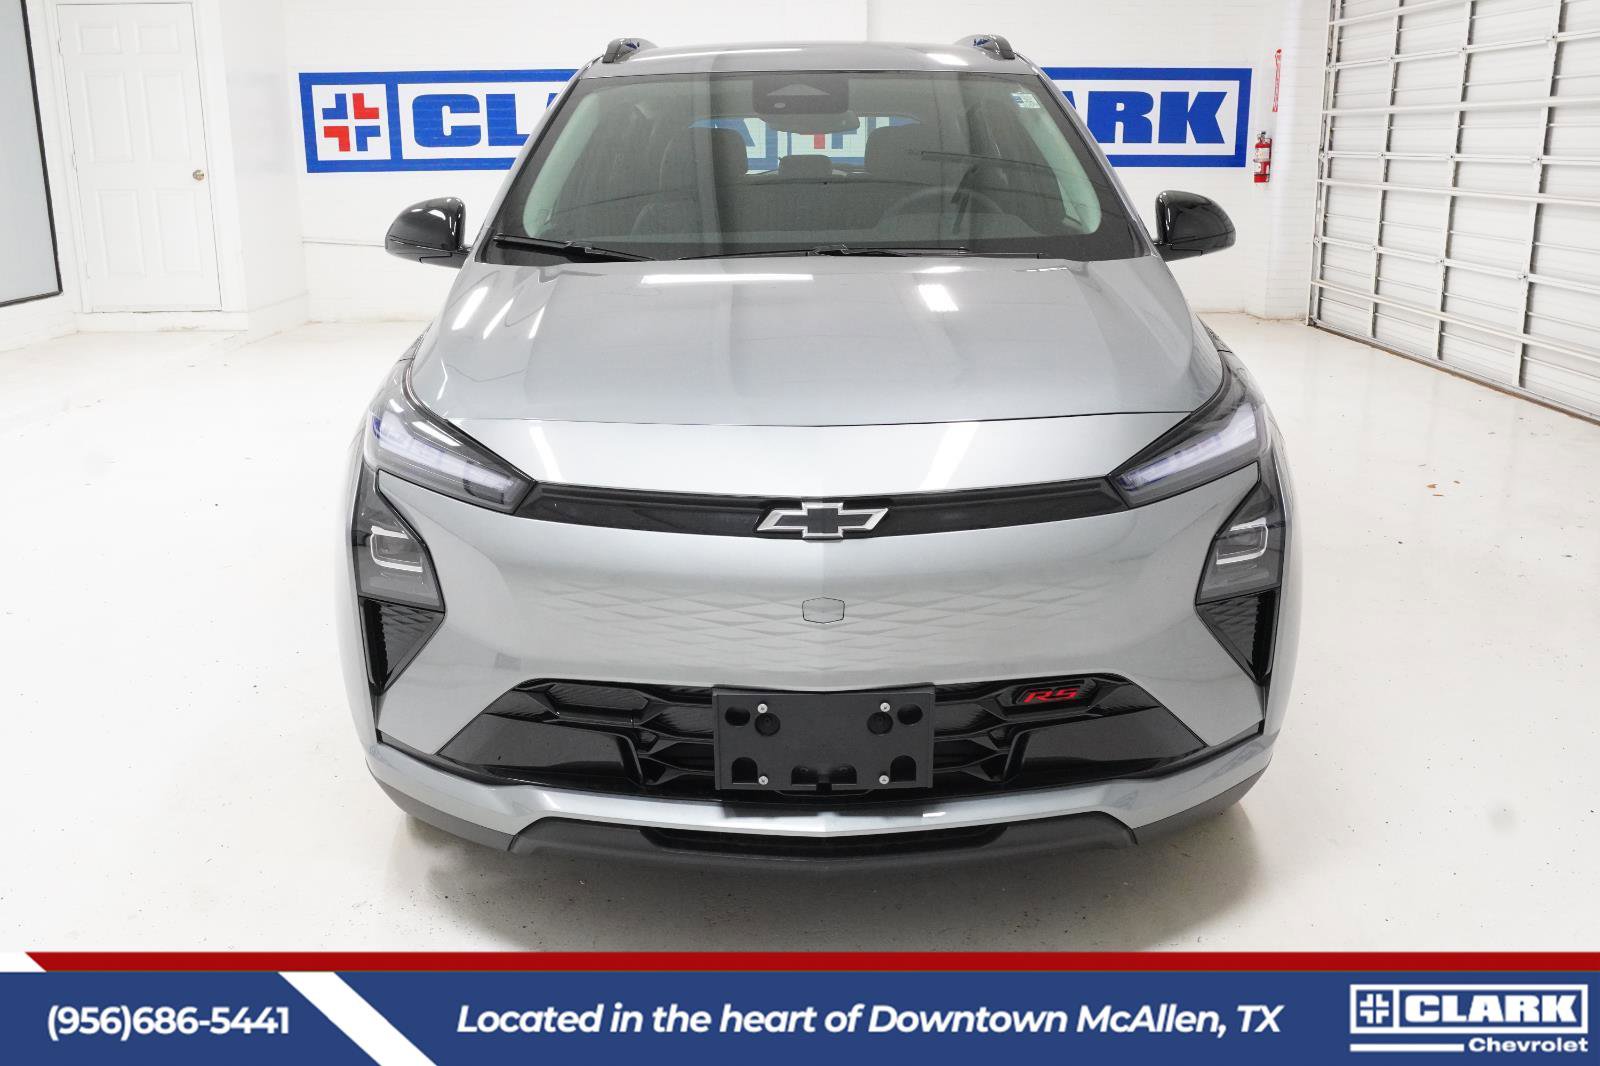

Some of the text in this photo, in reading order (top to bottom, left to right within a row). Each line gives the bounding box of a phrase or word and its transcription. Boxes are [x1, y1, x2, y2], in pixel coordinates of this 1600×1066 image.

[411, 93, 556, 148] CL
[1064, 91, 1228, 144] RK
[1023, 687, 1079, 703] RS
